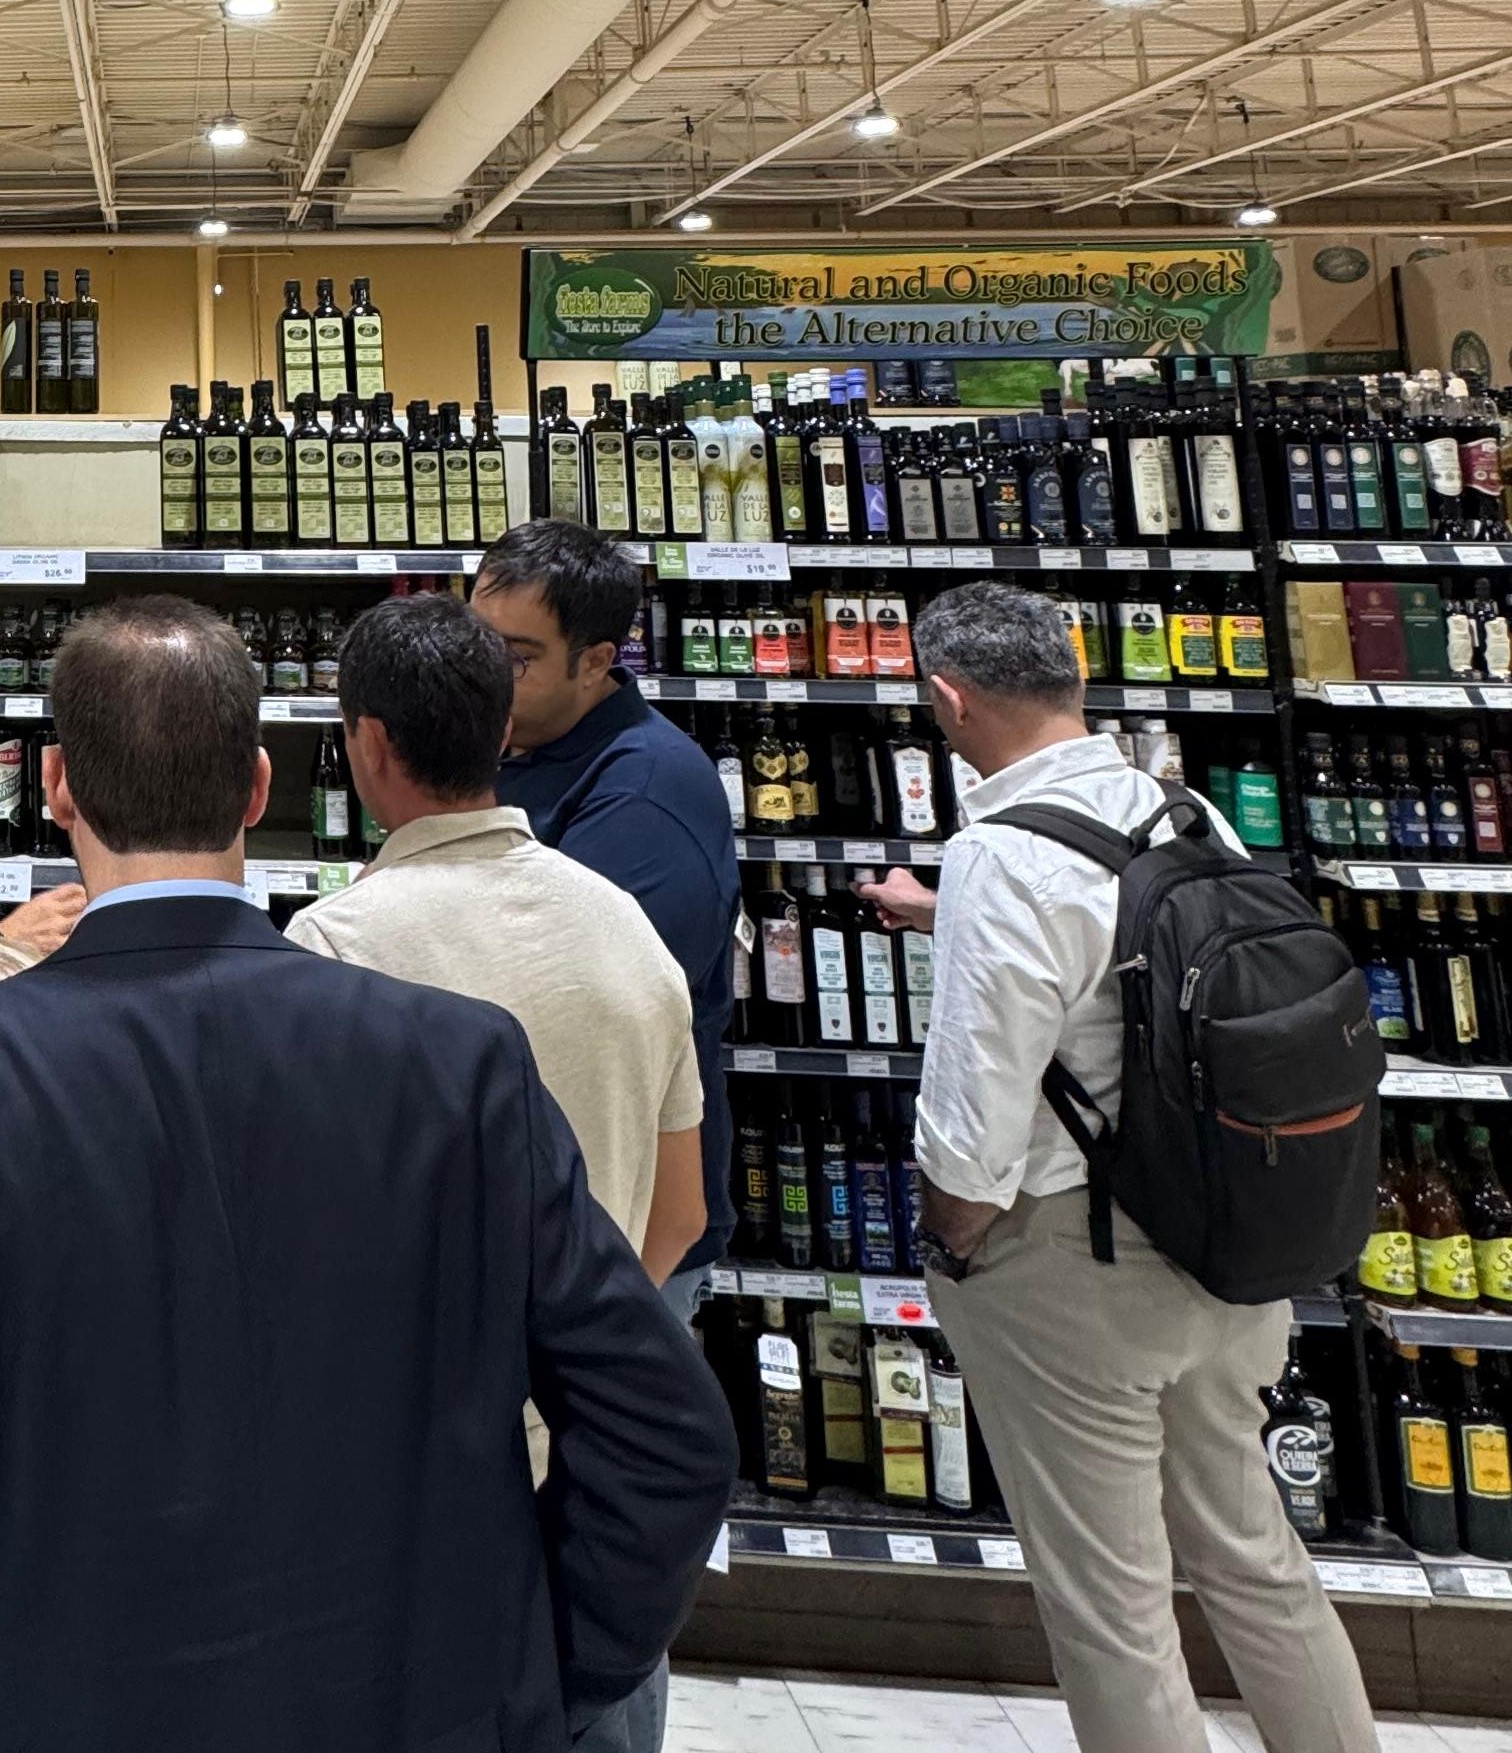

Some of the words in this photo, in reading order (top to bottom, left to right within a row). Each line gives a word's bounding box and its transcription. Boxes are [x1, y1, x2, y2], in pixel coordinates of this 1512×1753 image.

[675, 266, 835, 302] Natural
[849, 264, 929, 300] and
[943, 262, 1112, 308] Organic
[1126, 259, 1248, 297] Foods
[715, 311, 784, 347] the
[797, 310, 1038, 346] Alternative
[1054, 307, 1205, 343] Choice
[623, 380, 647, 391] LUZ
[707, 510, 728, 523] UZ
[743, 510, 769, 523] LUZ
